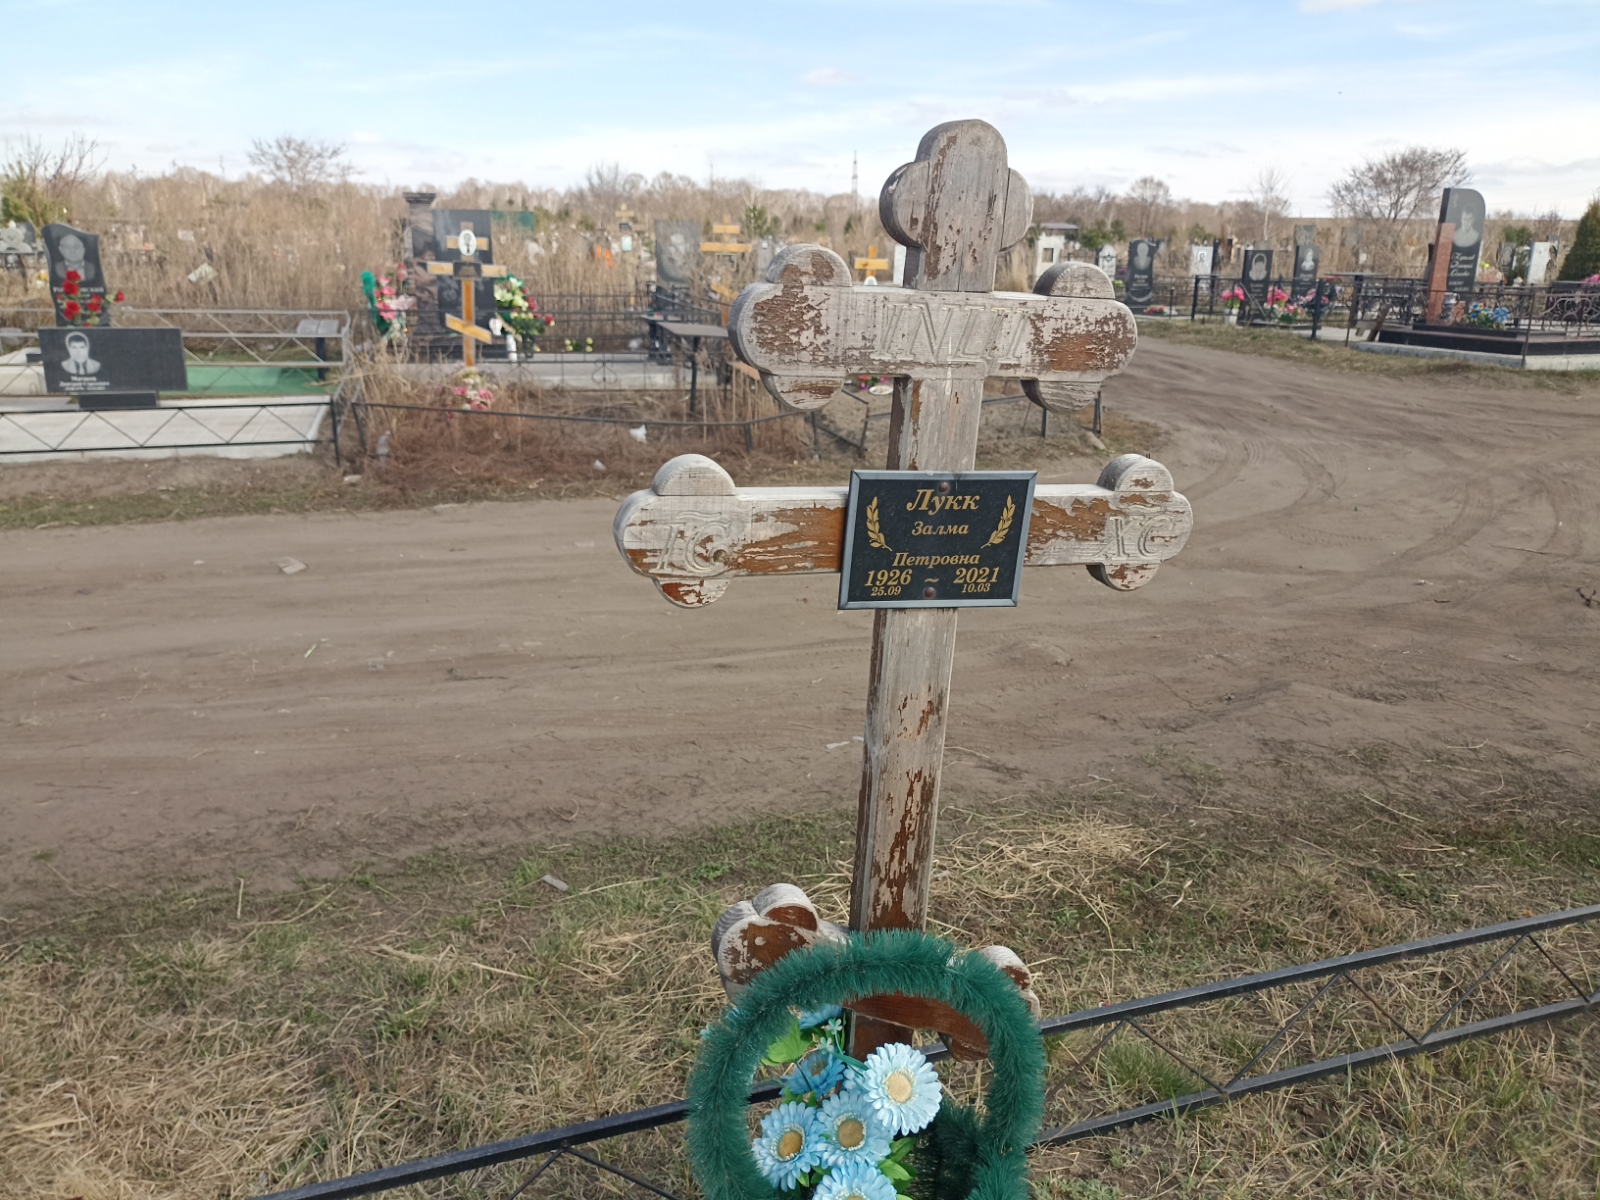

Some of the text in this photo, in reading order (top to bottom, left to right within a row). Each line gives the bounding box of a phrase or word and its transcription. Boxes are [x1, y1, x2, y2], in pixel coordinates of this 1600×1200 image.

[905, 488, 980, 516] Лукк
[911, 521, 970, 536] Залма
[891, 552, 981, 569] Петровна
[864, 568, 913, 587] 1926
[952, 566, 1000, 584] 2021
[870, 585, 902, 597] 25.09
[961, 583, 991, 594] 10.03
